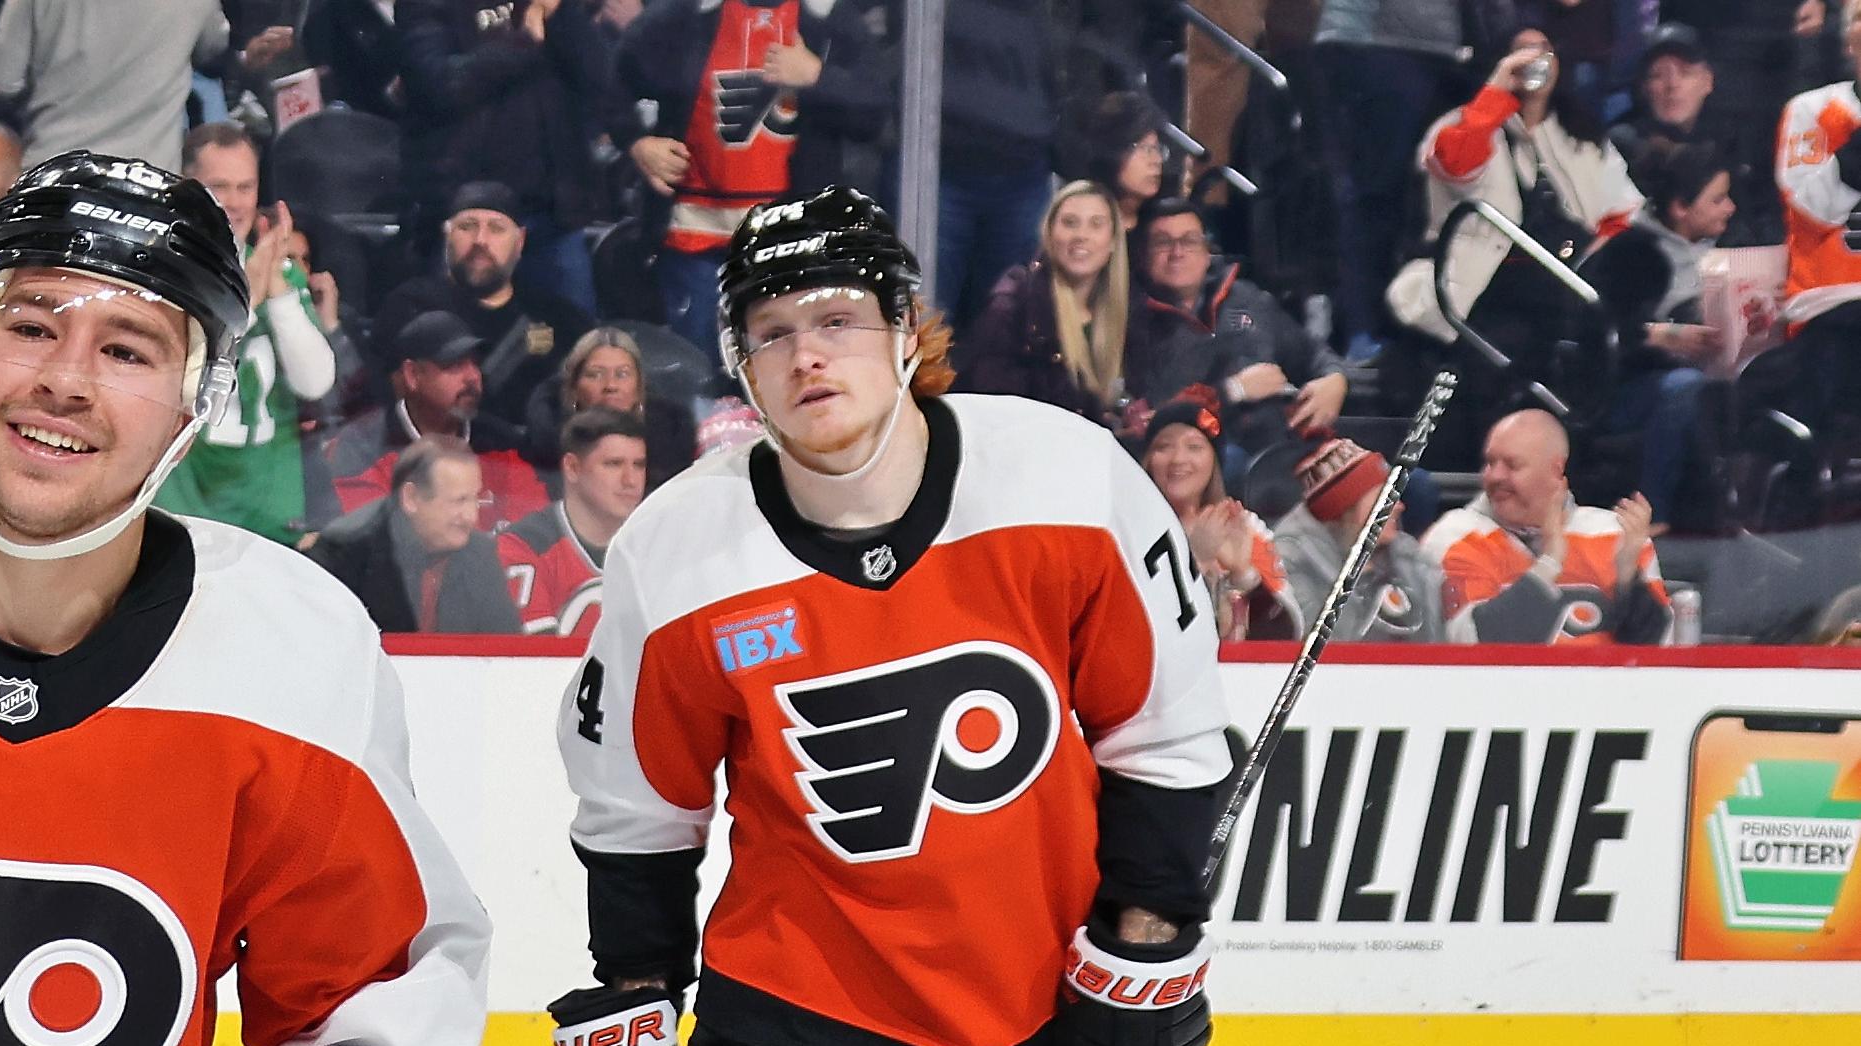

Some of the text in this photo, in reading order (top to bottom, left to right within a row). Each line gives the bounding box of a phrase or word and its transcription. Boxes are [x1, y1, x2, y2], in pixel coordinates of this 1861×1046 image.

[70, 201, 170, 236] BAUER
[754, 236, 824, 264] CCM
[716, 619, 804, 673] IBX
[1213, 727, 1655, 923] NLINE
[1741, 821, 1854, 839] PENNSYLVANIA
[1740, 840, 1854, 865] LOTTERY
